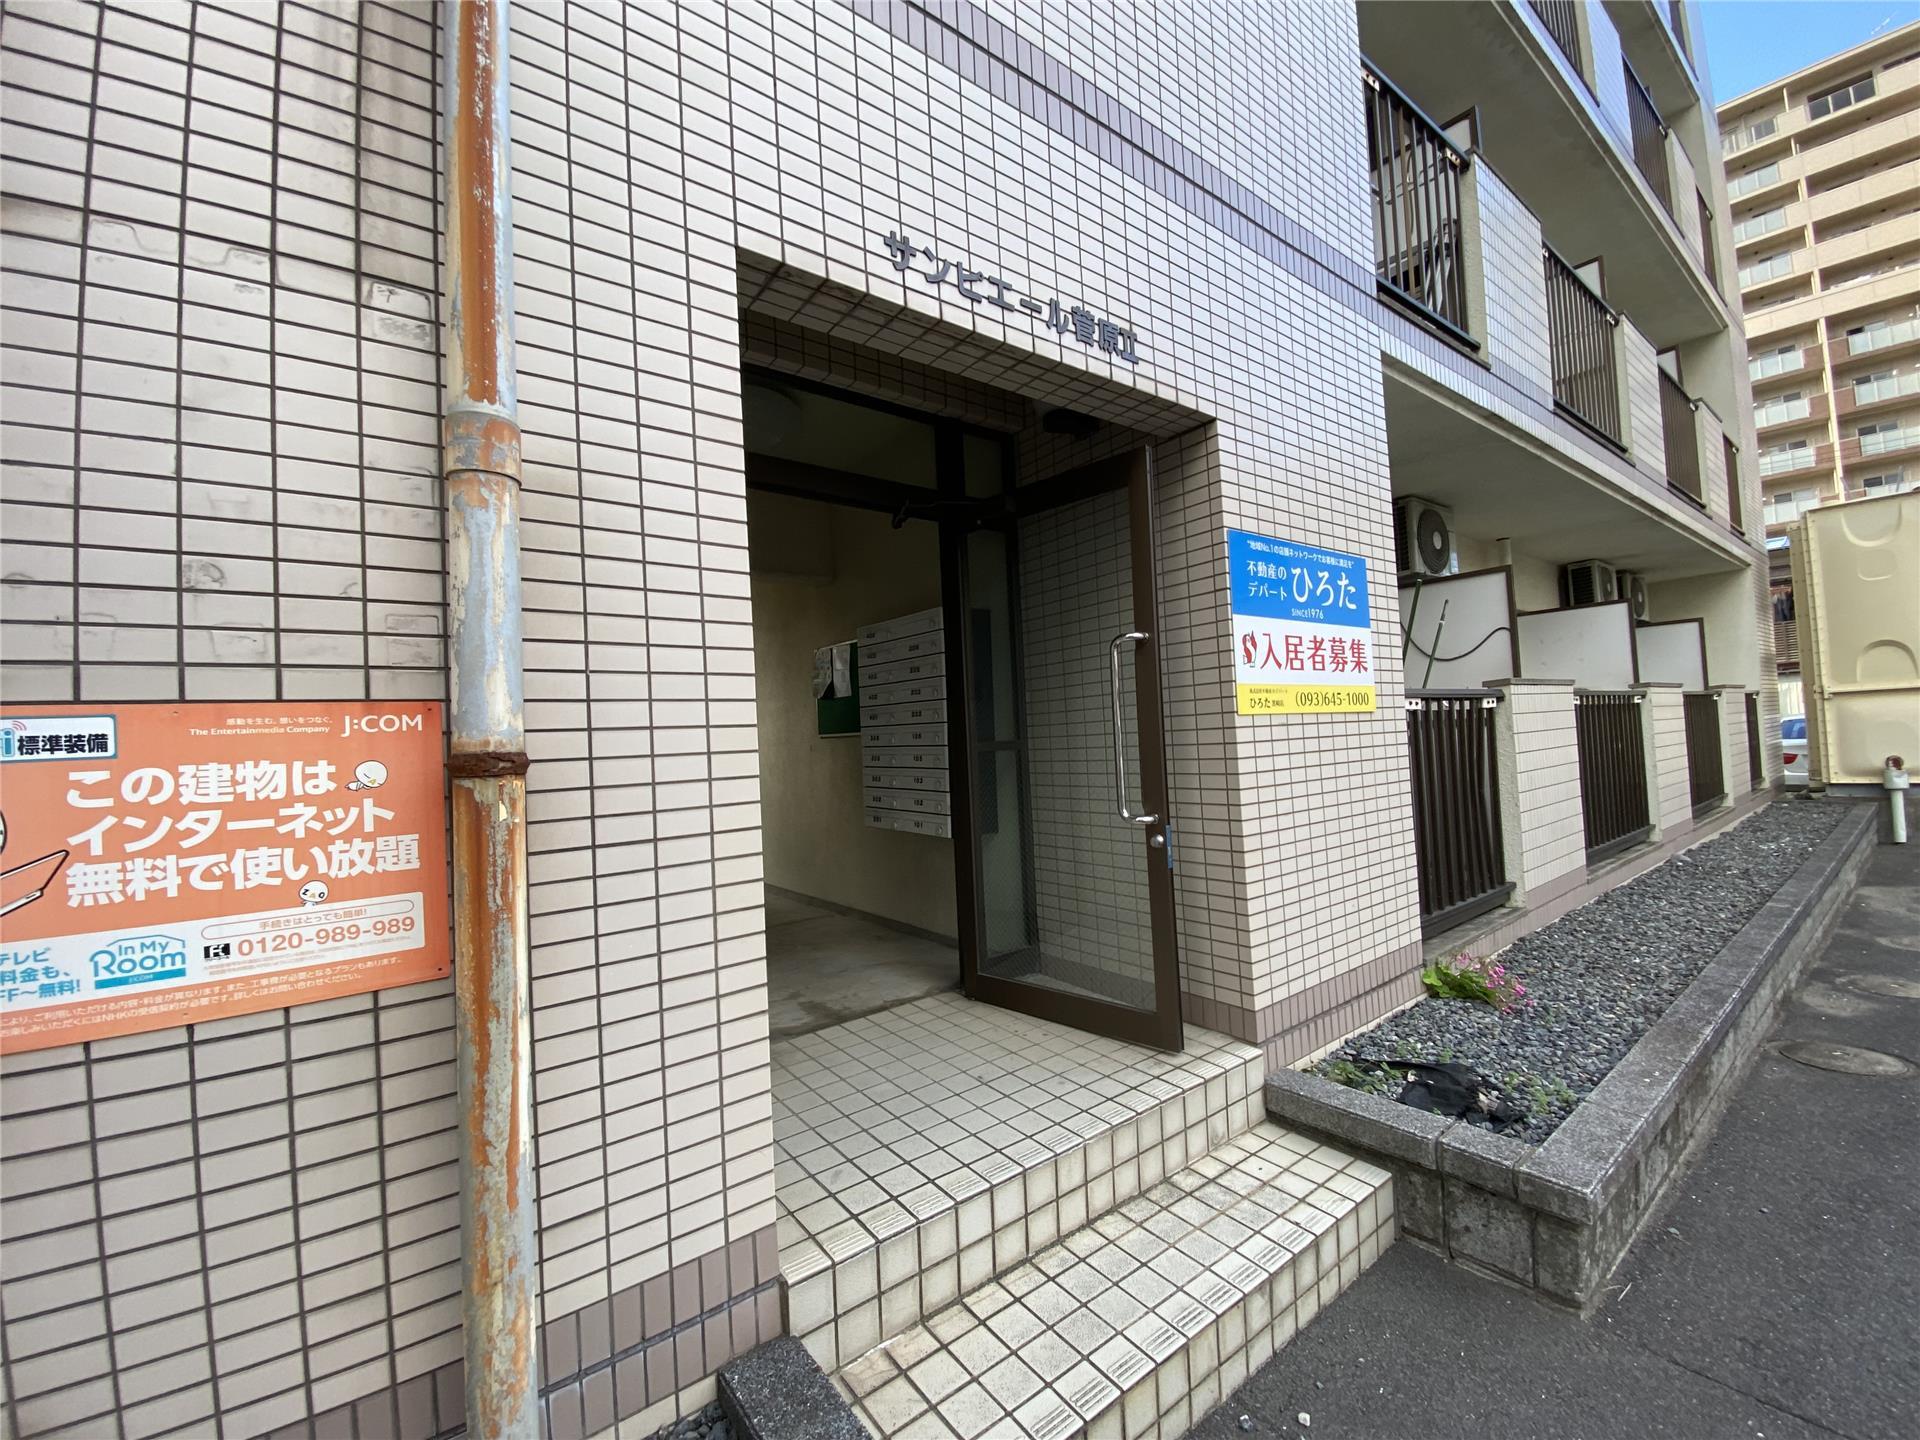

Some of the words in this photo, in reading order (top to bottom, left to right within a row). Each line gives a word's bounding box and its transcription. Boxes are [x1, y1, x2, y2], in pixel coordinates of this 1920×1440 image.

[1247, 560, 1287, 580] 不動産の
[1247, 582, 1287, 601] デパート
[1290, 567, 1357, 610] ひろた
[1260, 632, 1368, 674] 入居者募集
[1295, 690, 1369, 707] (093)645-1000
[190, 728, 208, 736] The
[286, 725, 330, 735] Company
[340, 714, 424, 738] J:COM
[17, 733, 109, 756] 標準装備
[67, 759, 336, 809] この建物は
[66, 798, 395, 856] インターネット
[66, 833, 420, 908] 無料で使い放題
[118, 944, 135, 956] In
[140, 941, 169, 953] My
[237, 915, 416, 957] 0120-989-989
[90, 949, 186, 977] Room
